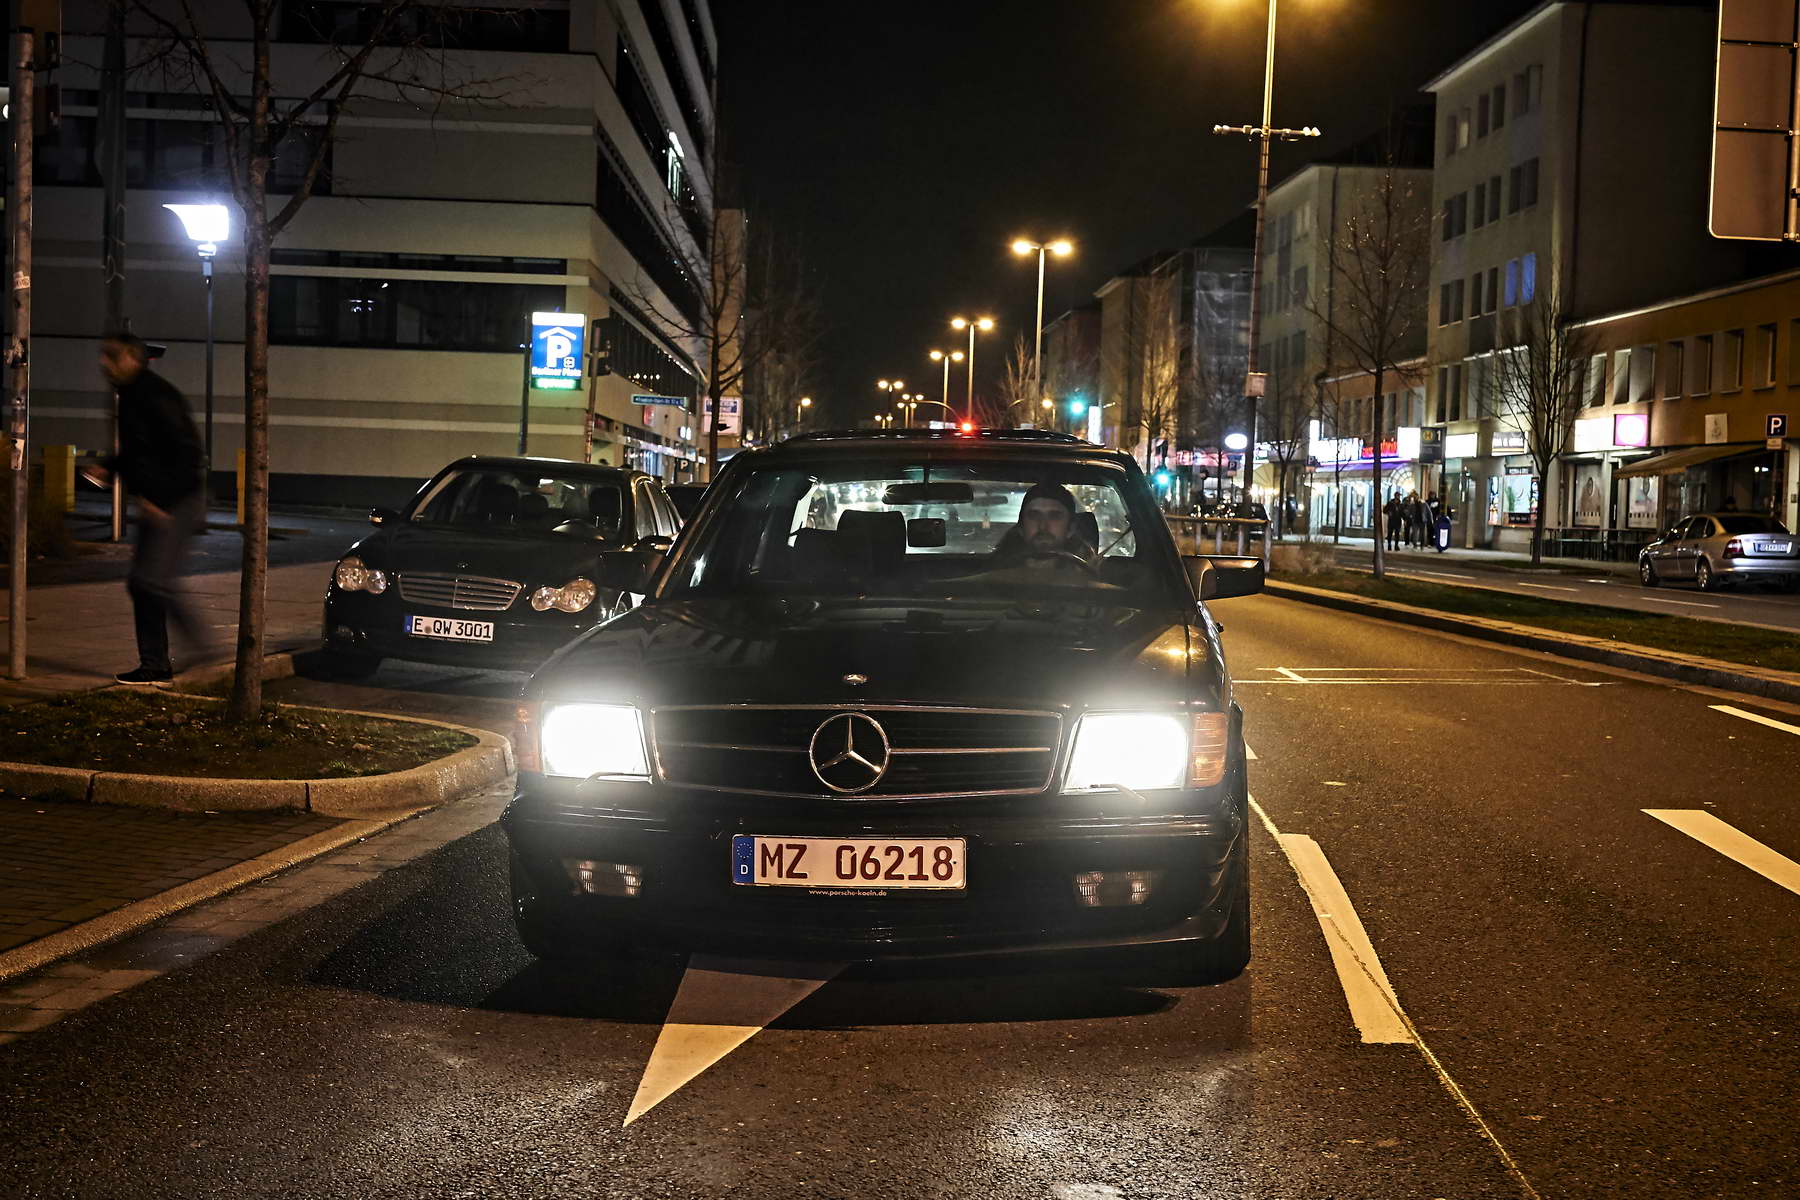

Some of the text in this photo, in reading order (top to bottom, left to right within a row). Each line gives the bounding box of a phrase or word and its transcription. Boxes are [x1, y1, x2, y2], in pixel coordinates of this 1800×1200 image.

[546, 335, 572, 367] P
[1770, 417, 1782, 435] P
[414, 618, 424, 633] E
[433, 620, 453, 635] QW
[455, 622, 491, 638] 3001
[740, 843, 953, 881] D MZ 06218
